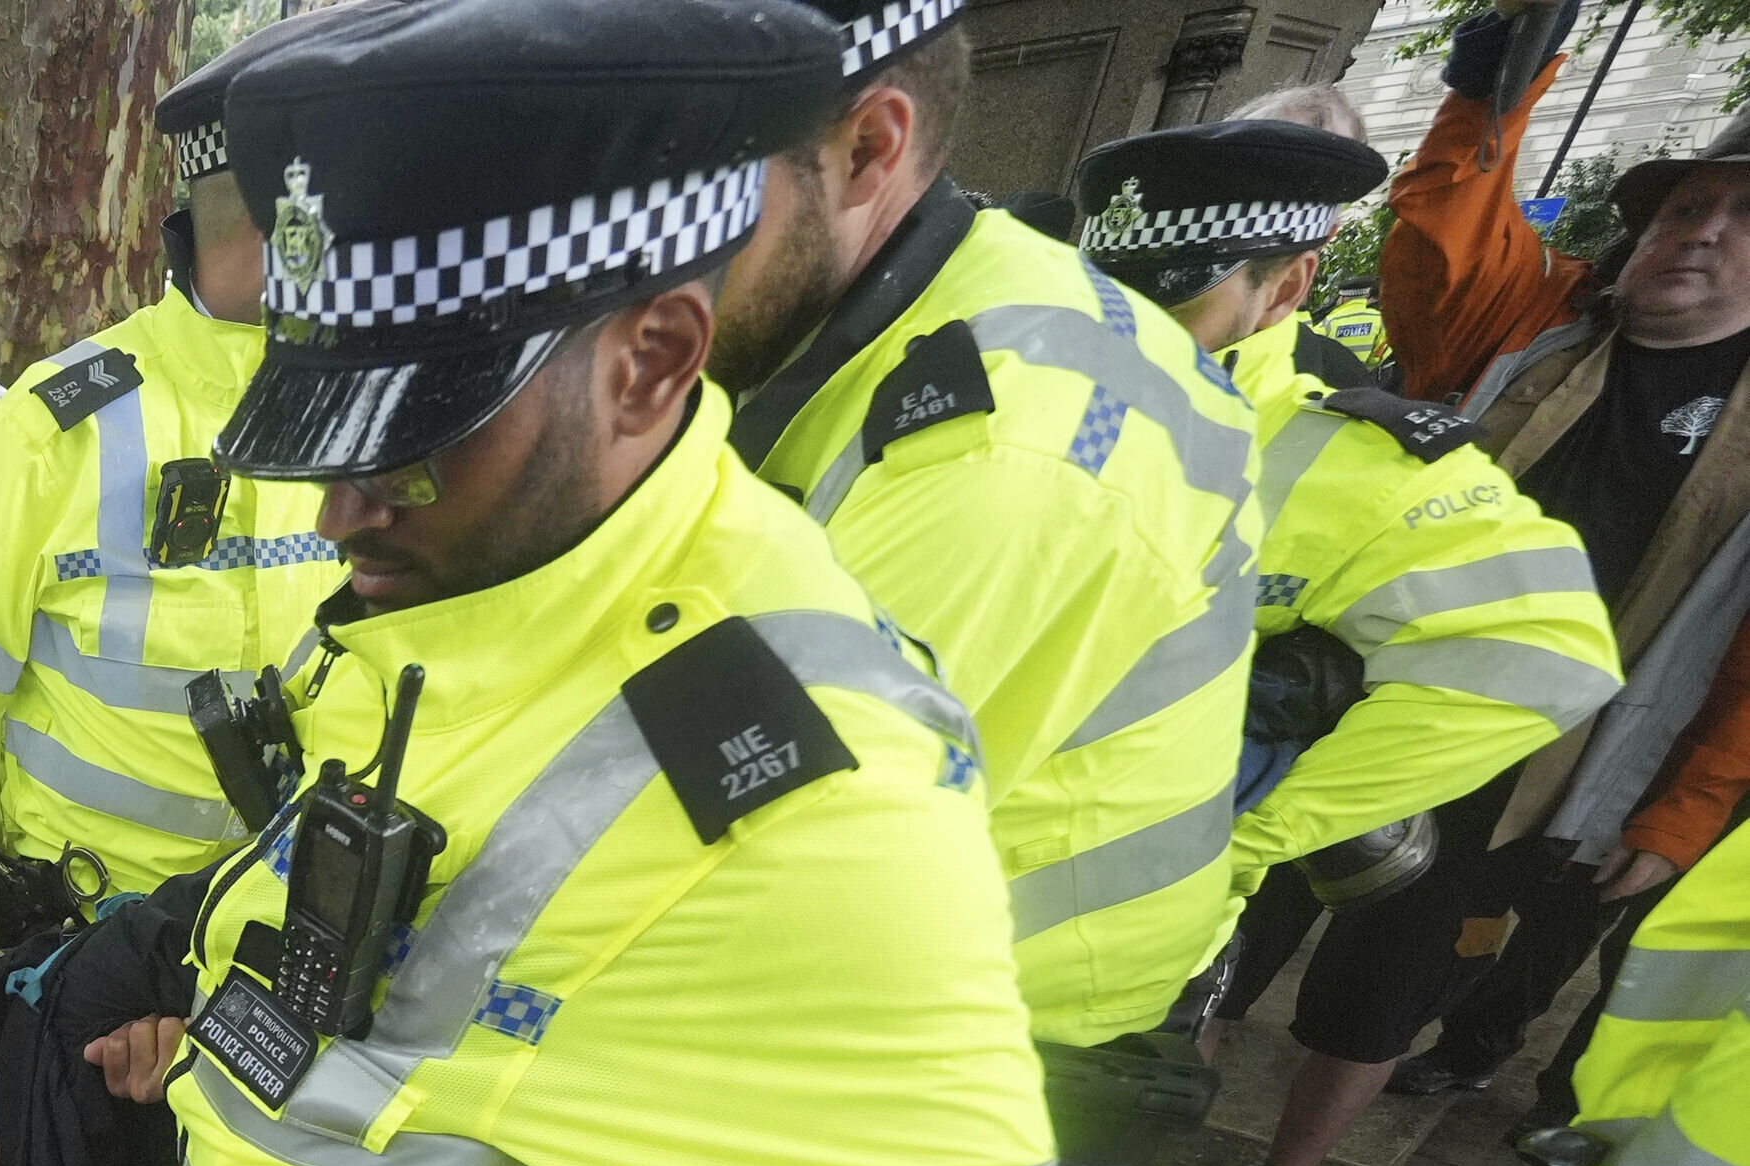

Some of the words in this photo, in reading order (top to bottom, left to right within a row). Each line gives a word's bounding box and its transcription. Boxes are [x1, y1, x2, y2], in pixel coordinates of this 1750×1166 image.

[48, 387, 71, 408] 234
[63, 381, 82, 399] EA
[902, 383, 939, 411] EA
[893, 392, 955, 430] 2461
[718, 723, 773, 767] NE
[720, 740, 800, 800] 2267
[247, 1024, 289, 1065] POLICE
[252, 1006, 304, 1056] METROPOLITAN
[199, 1016, 244, 1060] POLICE
[237, 1050, 285, 1099] OFFICER
